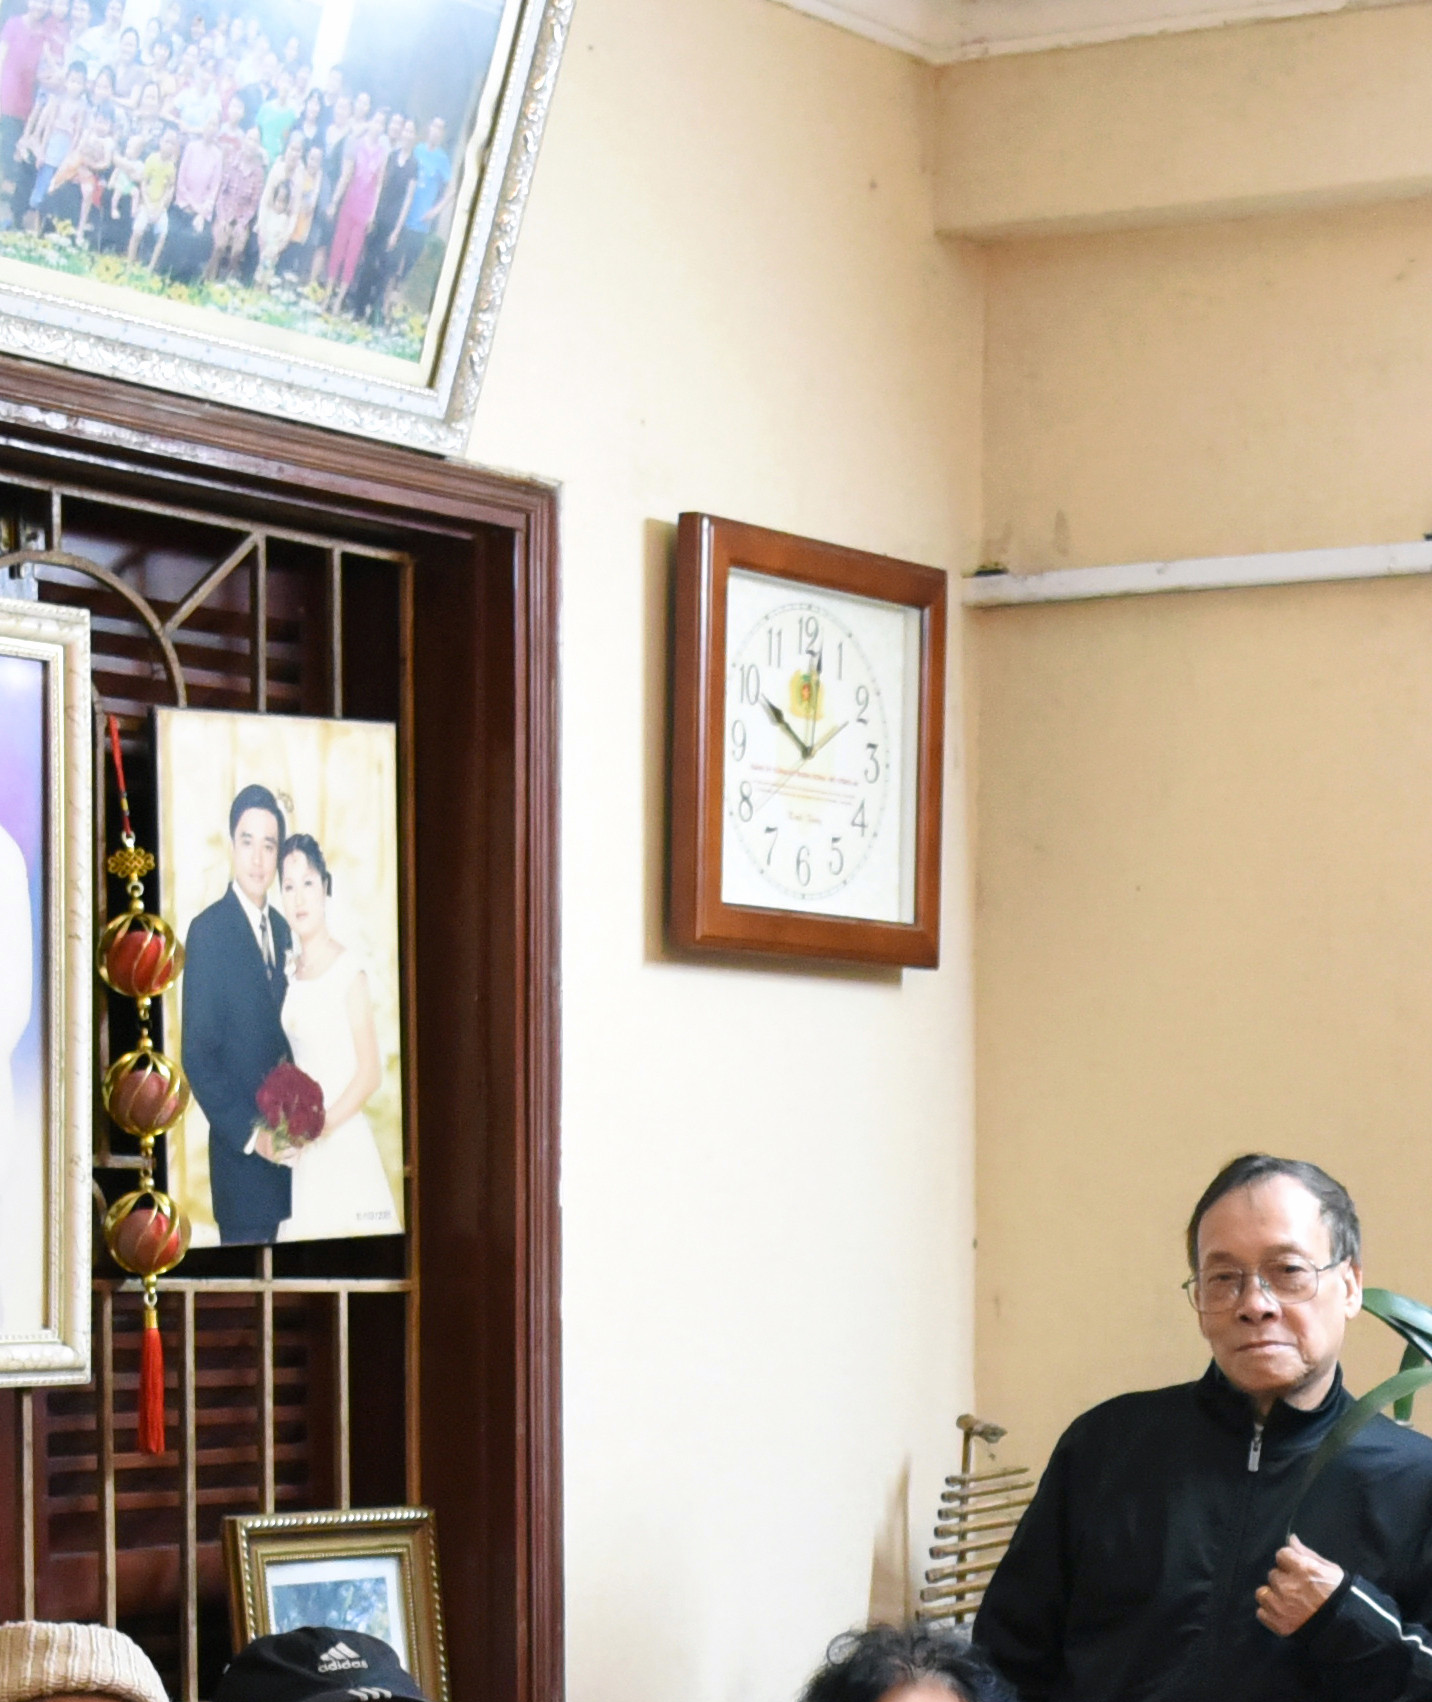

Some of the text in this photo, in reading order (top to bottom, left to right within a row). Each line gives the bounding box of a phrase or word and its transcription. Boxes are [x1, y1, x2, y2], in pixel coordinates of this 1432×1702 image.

[768, 627, 782, 668] 11
[798, 616, 819, 657] 12
[837, 641, 844, 681] 1
[740, 663, 760, 706] 10
[855, 684, 869, 725] 2
[731, 719, 747, 762] 9
[864, 742, 880, 784] 3
[738, 780, 754, 823] 8
[850, 798, 868, 838] 4
[764, 826, 778, 866] 7
[796, 845, 811, 887] 6
[829, 836, 844, 876] 5
[318, 1658, 368, 1673] adidas
